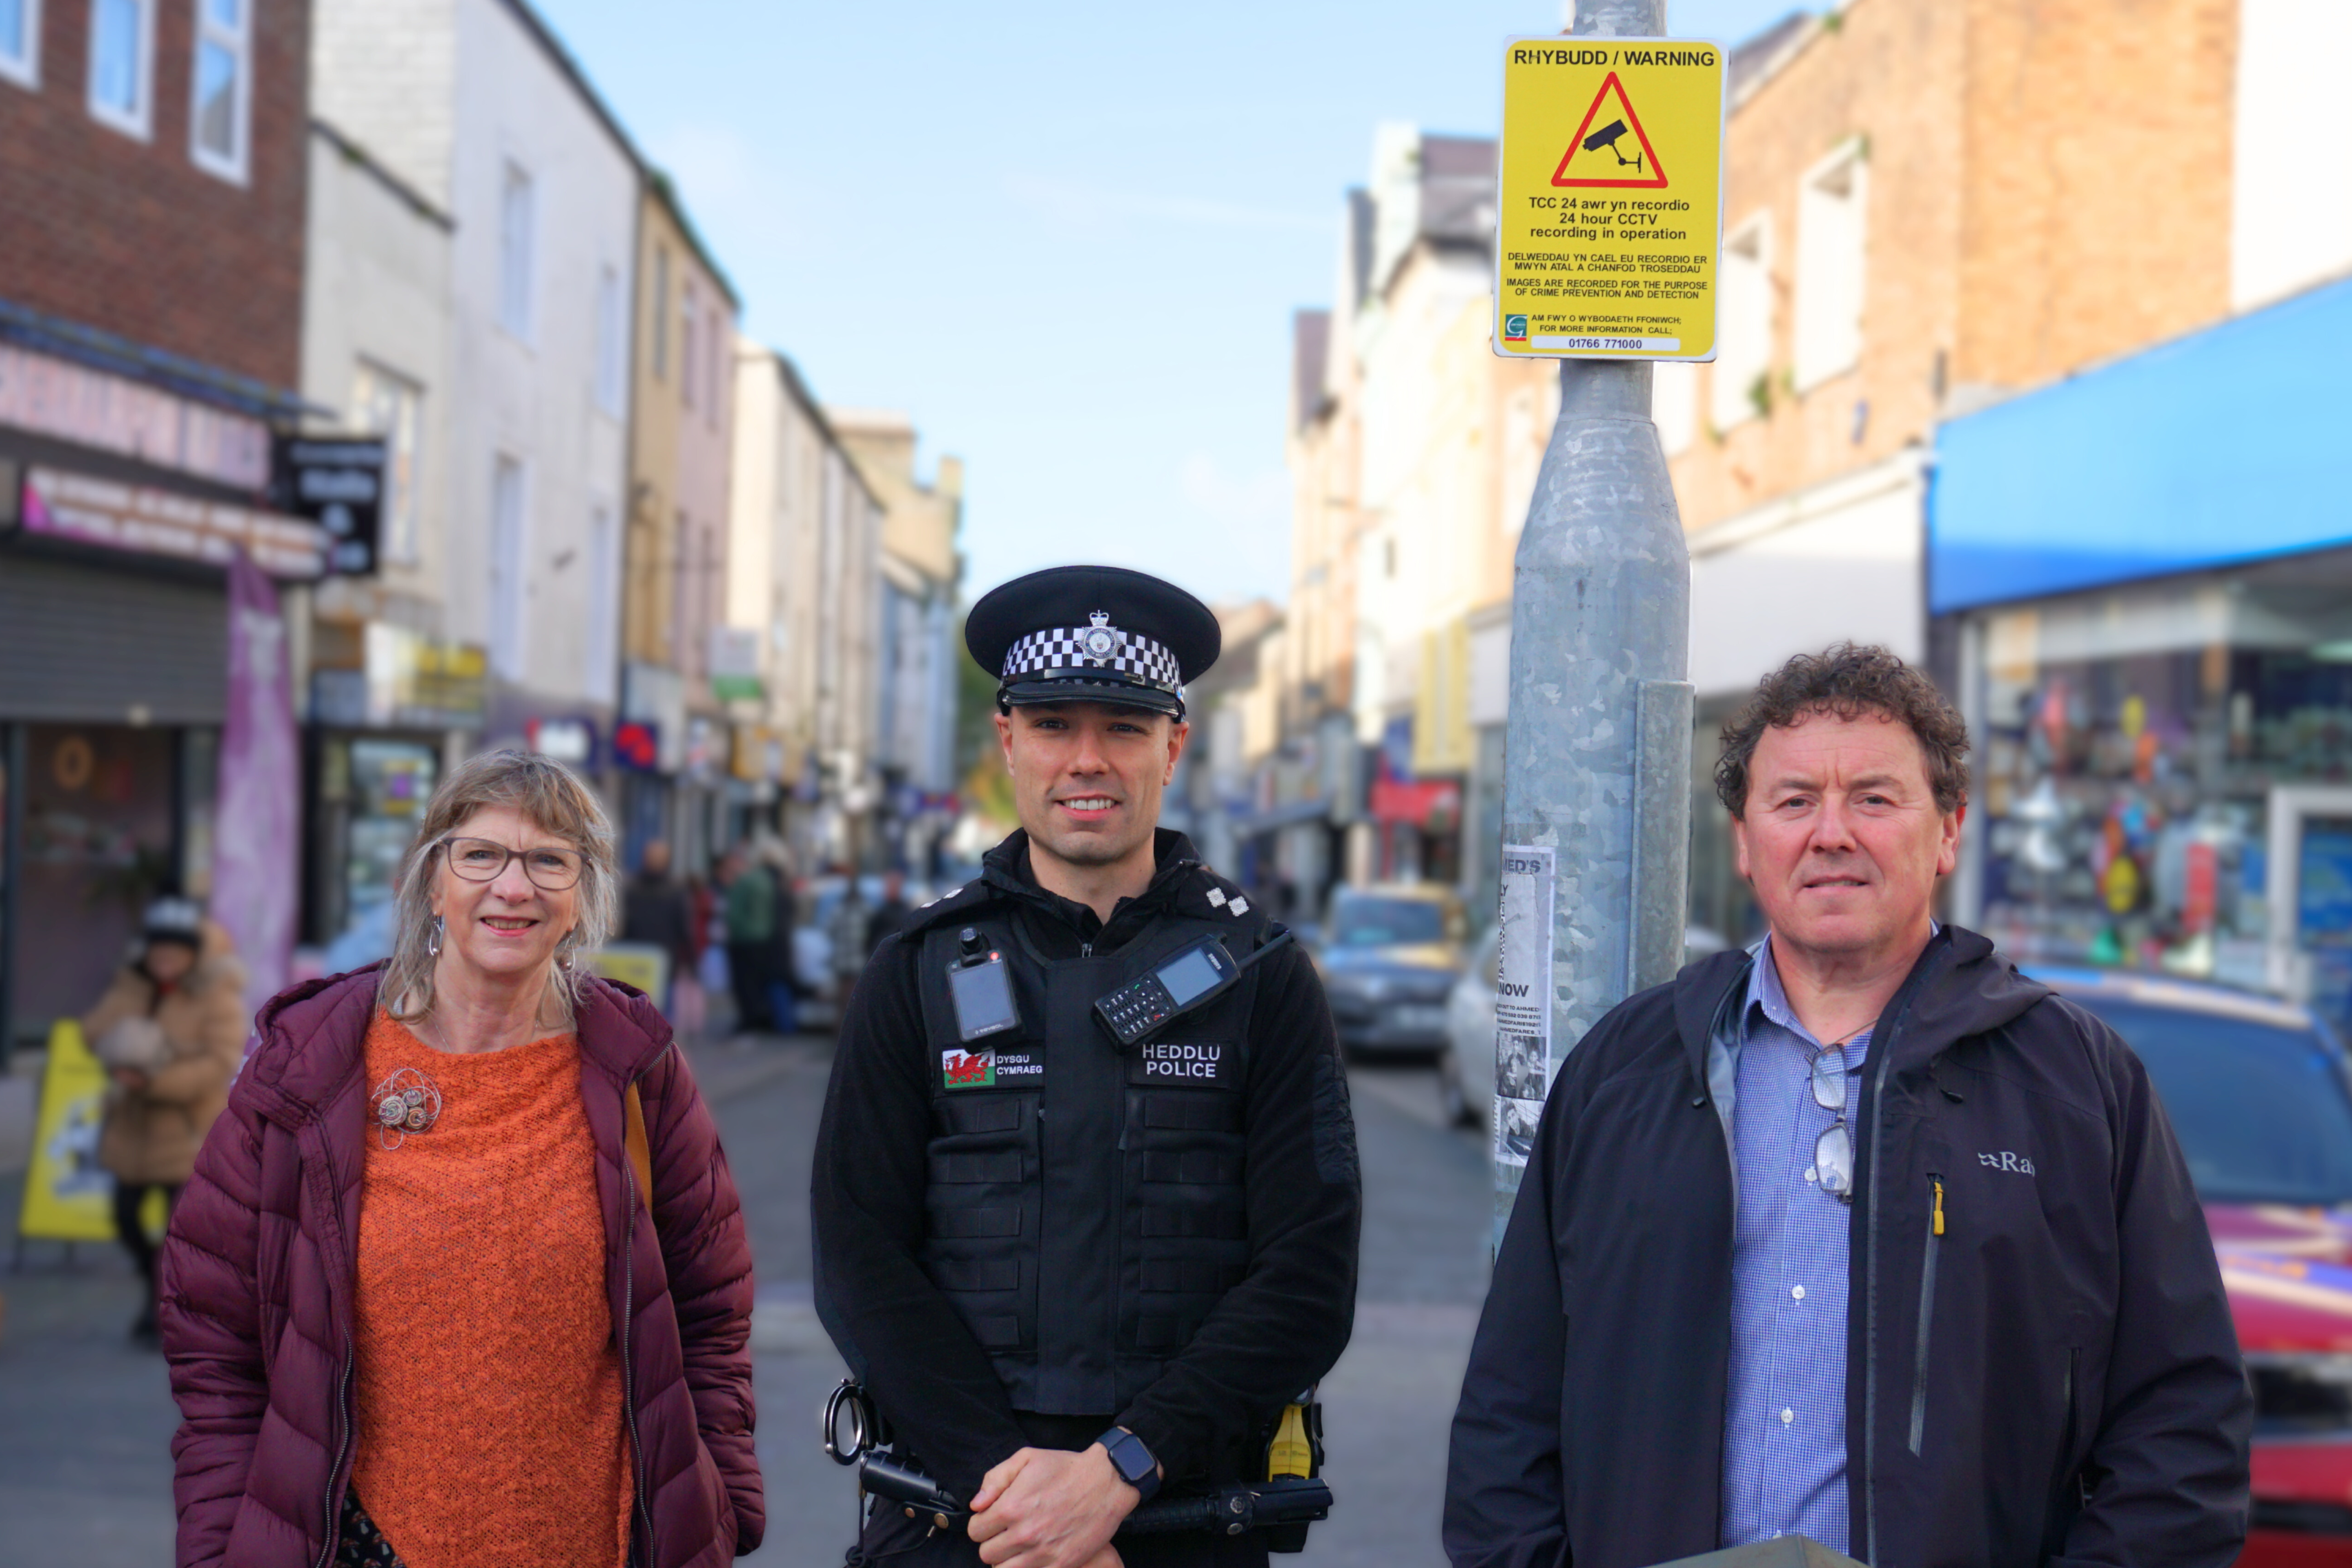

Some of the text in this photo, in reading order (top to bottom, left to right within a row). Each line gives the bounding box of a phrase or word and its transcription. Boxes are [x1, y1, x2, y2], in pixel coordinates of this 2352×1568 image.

[1515, 50, 1714, 66] RHYBUDD / WARNING
[1529, 197, 1690, 212] TCC 24 awr yn recordio
[1560, 212, 1657, 225] 24 hour CCTV
[1531, 227, 1686, 241] recording in operation
[1508, 252, 1569, 261] DELWEDDAU
[1590, 254, 1617, 262] CAEL
[1621, 254, 1633, 263] EU
[1637, 255, 1690, 263] RECORDIO
[1694, 256, 1707, 264] ER
[1515, 262, 1546, 270] MWYN
[1588, 263, 1636, 272] CHANFOD
[1640, 264, 1700, 273] TROSEDDAU
[1507, 278, 1541, 287] IMAGES
[1567, 279, 1618, 288] RECORDED
[1621, 280, 1640, 289] FOR
[1643, 281, 1661, 289] THE
[1664, 281, 1707, 290] PURPOSE
[1531, 288, 1559, 296] CRIME
[1563, 289, 1621, 298] PREVENTION
[1647, 290, 1699, 299] DETECTION
[1569, 339, 1642, 349] 01766 771000
[1142, 1044, 1221, 1061] HEDDLU
[996, 1054, 1029, 1064] DYSGU
[996, 1065, 1043, 1076] CYMRAEG
[1146, 1061, 1216, 1078] POLICE
